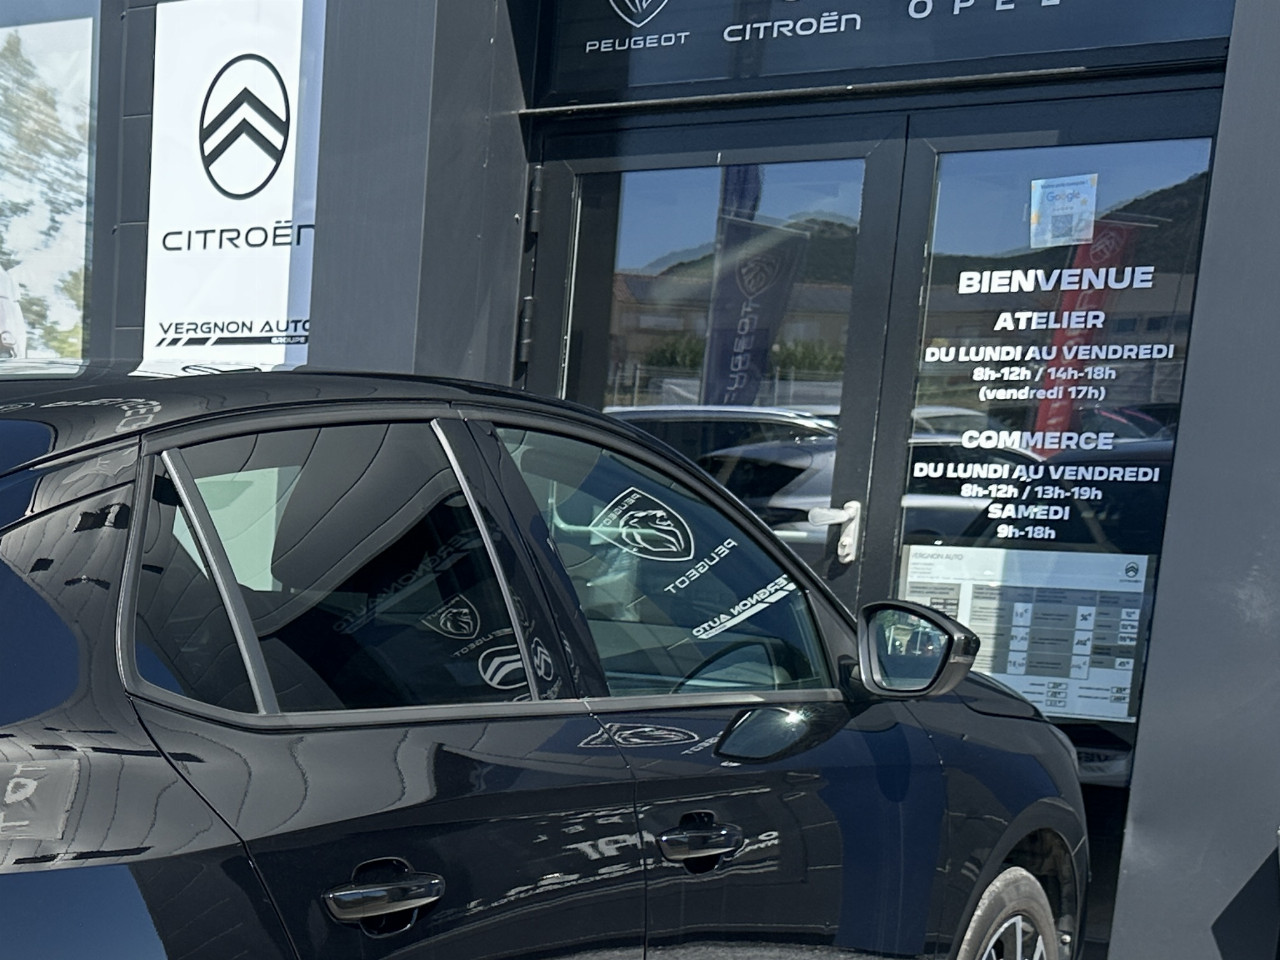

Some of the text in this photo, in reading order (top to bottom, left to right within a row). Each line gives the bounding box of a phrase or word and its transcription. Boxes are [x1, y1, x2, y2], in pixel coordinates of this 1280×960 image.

[908, 0, 1061, 19] OPE
[585, 31, 691, 53] PEUGEOT
[958, 266, 1155, 294] BIENVENUE
[159, 320, 253, 335] VERGNON
[994, 311, 1106, 331] ATELIER
[925, 344, 1175, 362] DU LUNDI AU VENDREDI
[972, 366, 1117, 382] 8h-12h / 14h-18h
[978, 386, 1106, 401] (vendredi 17h)
[961, 430, 1115, 450] COMMERCE
[913, 462, 1161, 482] DU LUNDI AU VENDREDI
[960, 483, 1103, 500] 8h-12h / 13h-19h
[987, 503, 1071, 520] SAMEDI
[996, 524, 1056, 539] 9h-18h
